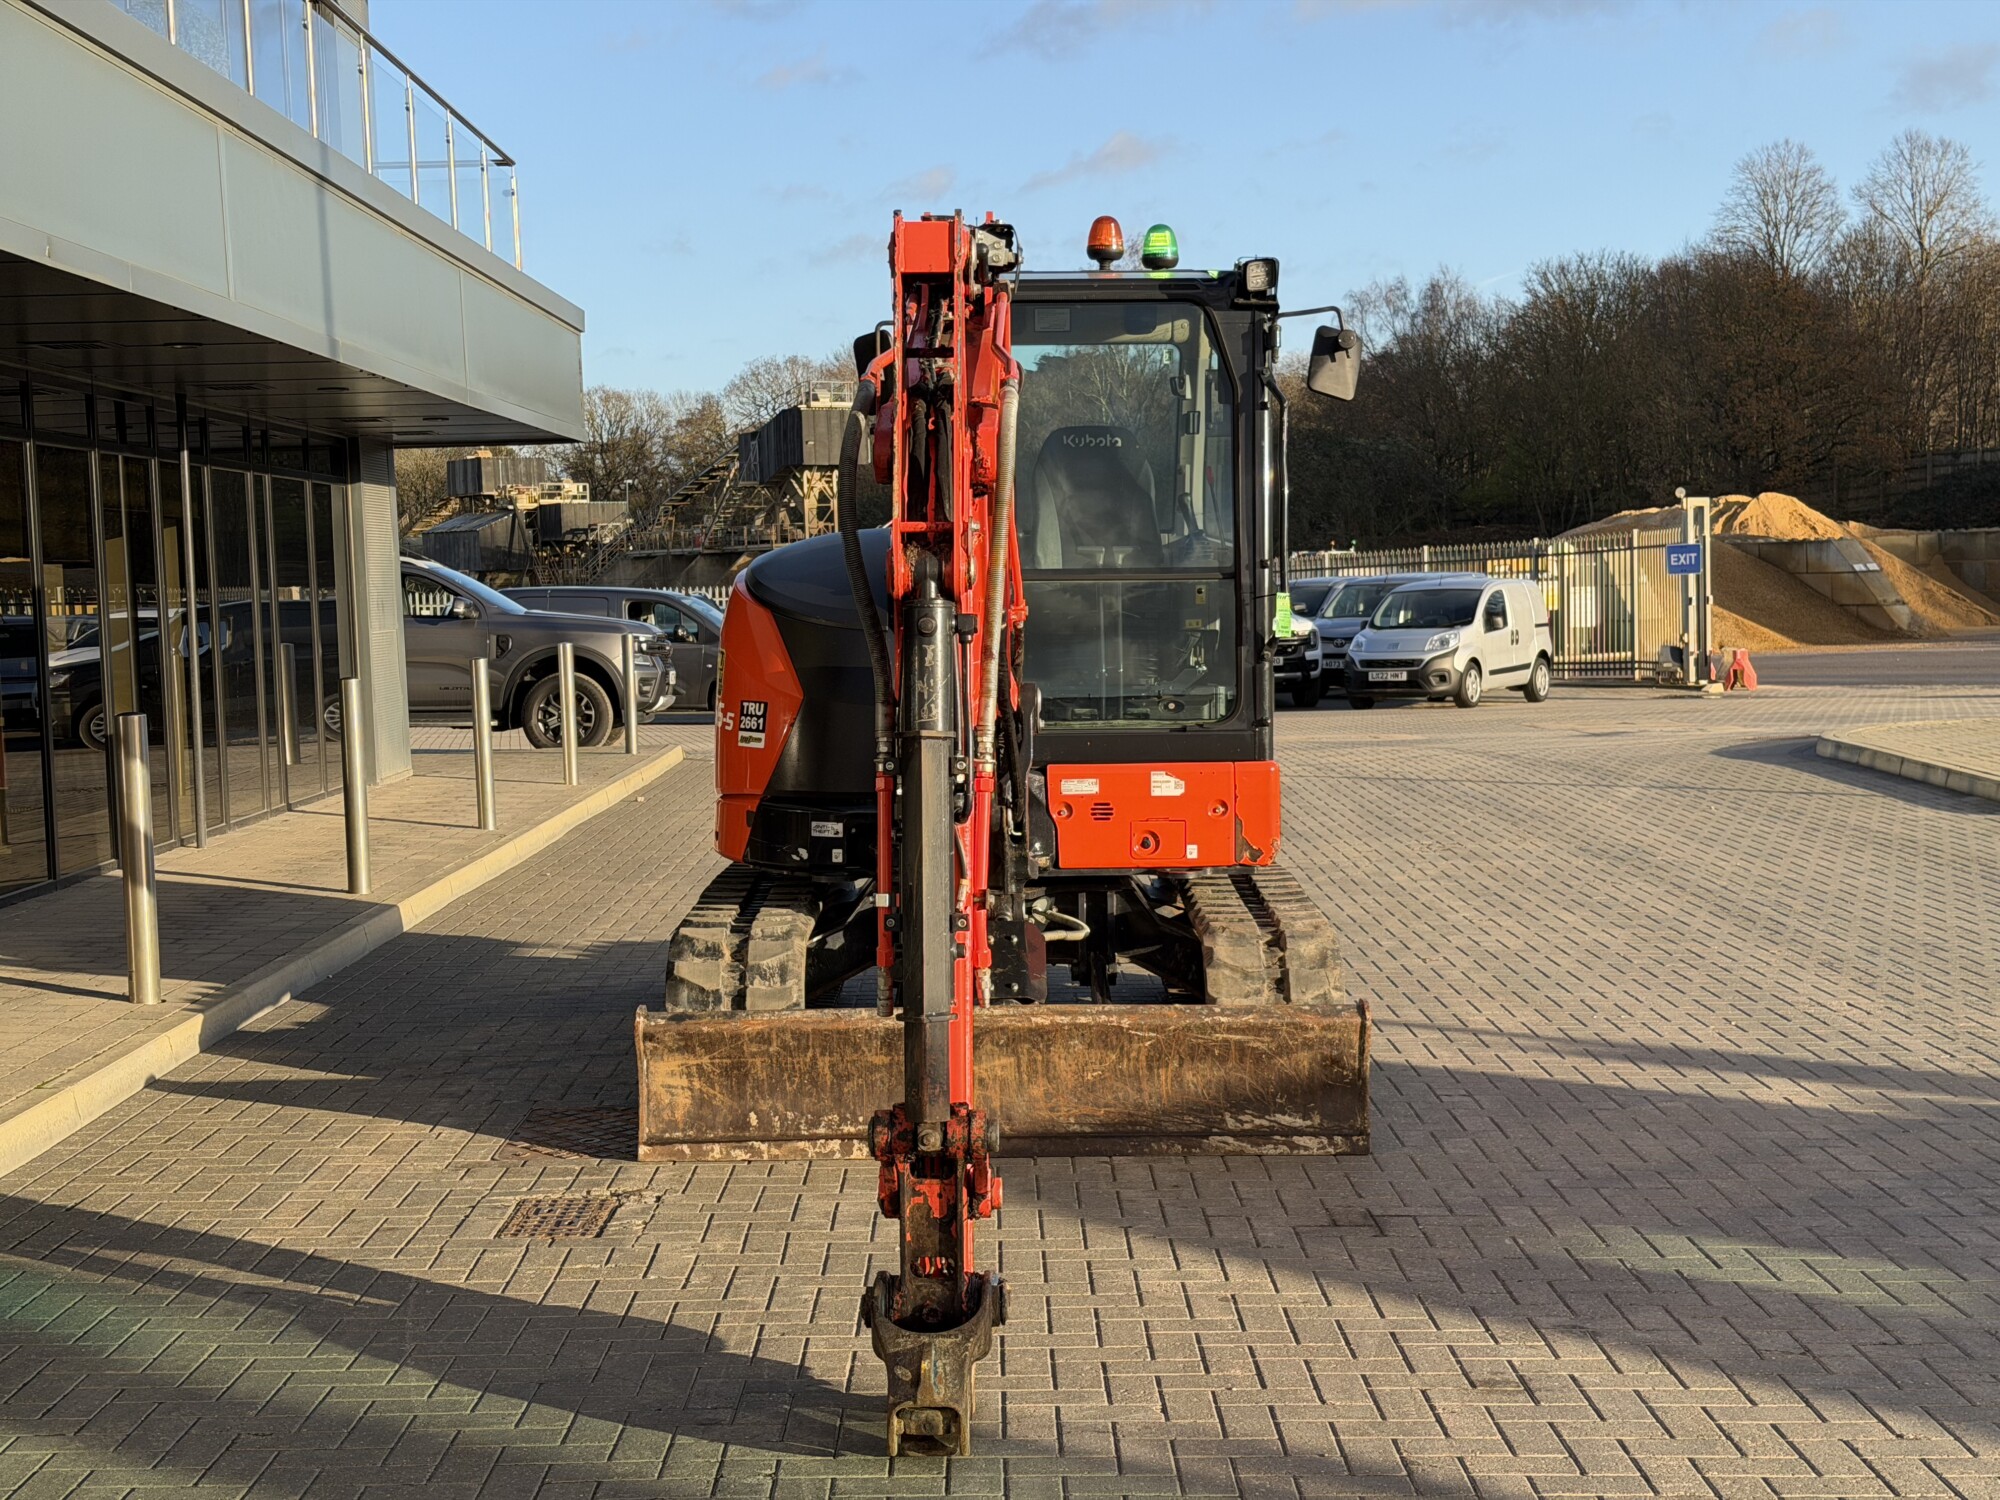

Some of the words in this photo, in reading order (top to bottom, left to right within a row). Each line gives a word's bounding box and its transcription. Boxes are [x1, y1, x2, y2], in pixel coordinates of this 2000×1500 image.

[1063, 434, 1122, 448] Kubota
[1670, 553, 1697, 566] EXIT
[742, 701, 765, 716] TRU
[740, 715, 764, 730] 2661
